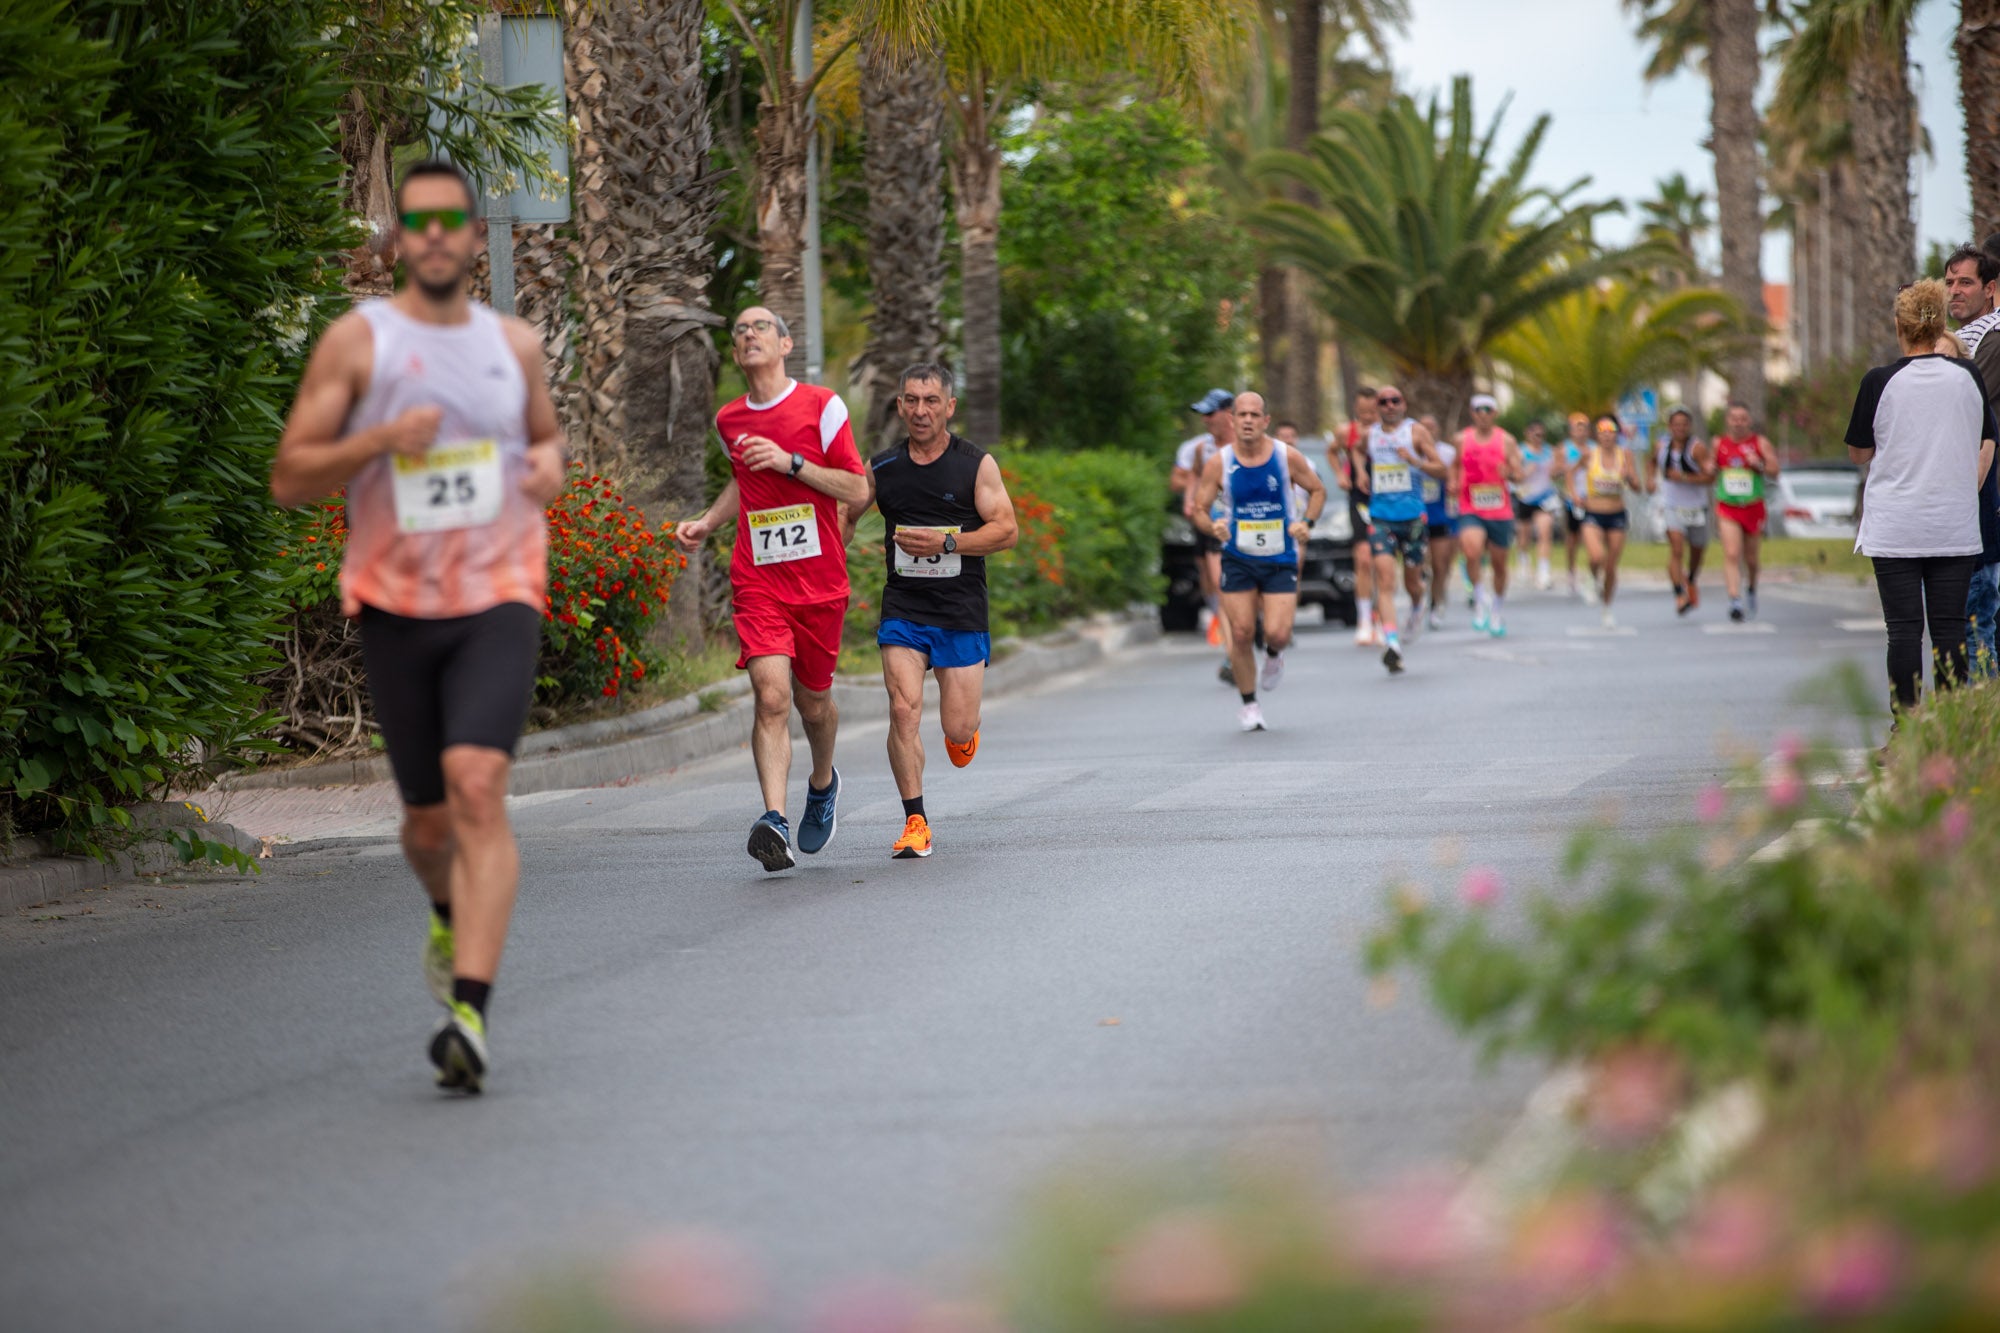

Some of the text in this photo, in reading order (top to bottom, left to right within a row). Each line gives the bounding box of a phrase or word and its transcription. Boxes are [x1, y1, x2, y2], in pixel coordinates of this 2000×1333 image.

[426, 475, 476, 507] 25
[759, 525, 807, 550] 712
[1256, 533, 1266, 547] 5
